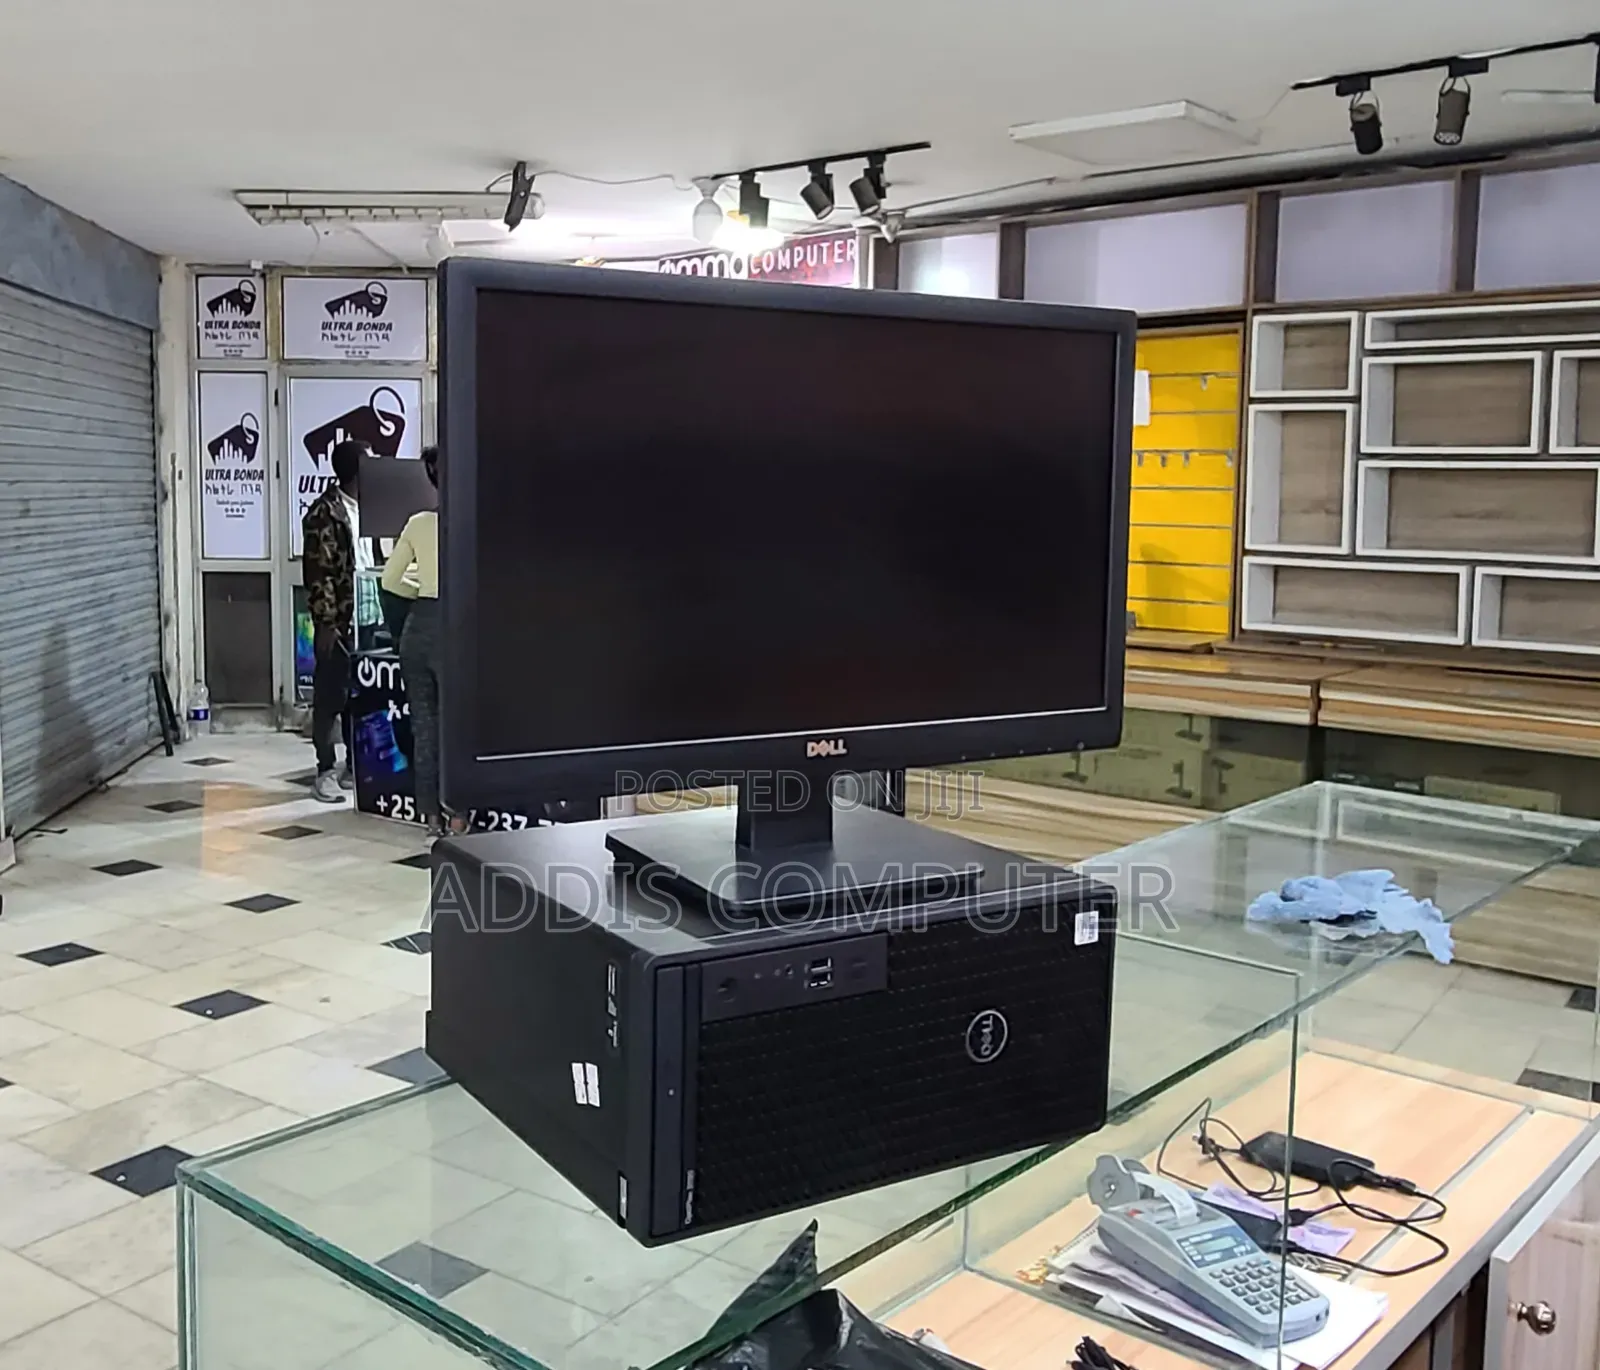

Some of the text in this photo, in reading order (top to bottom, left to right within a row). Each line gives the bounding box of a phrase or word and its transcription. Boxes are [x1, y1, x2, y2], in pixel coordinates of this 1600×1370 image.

[750, 238, 857, 274] COMPUTER
[204, 320, 261, 330] ULTRA BONDA
[321, 321, 393, 331] ULTRA BONDA
[205, 468, 264, 481] ULTRA BONDA
[298, 475, 338, 494] ULTR
[806, 739, 848, 758] DELL
